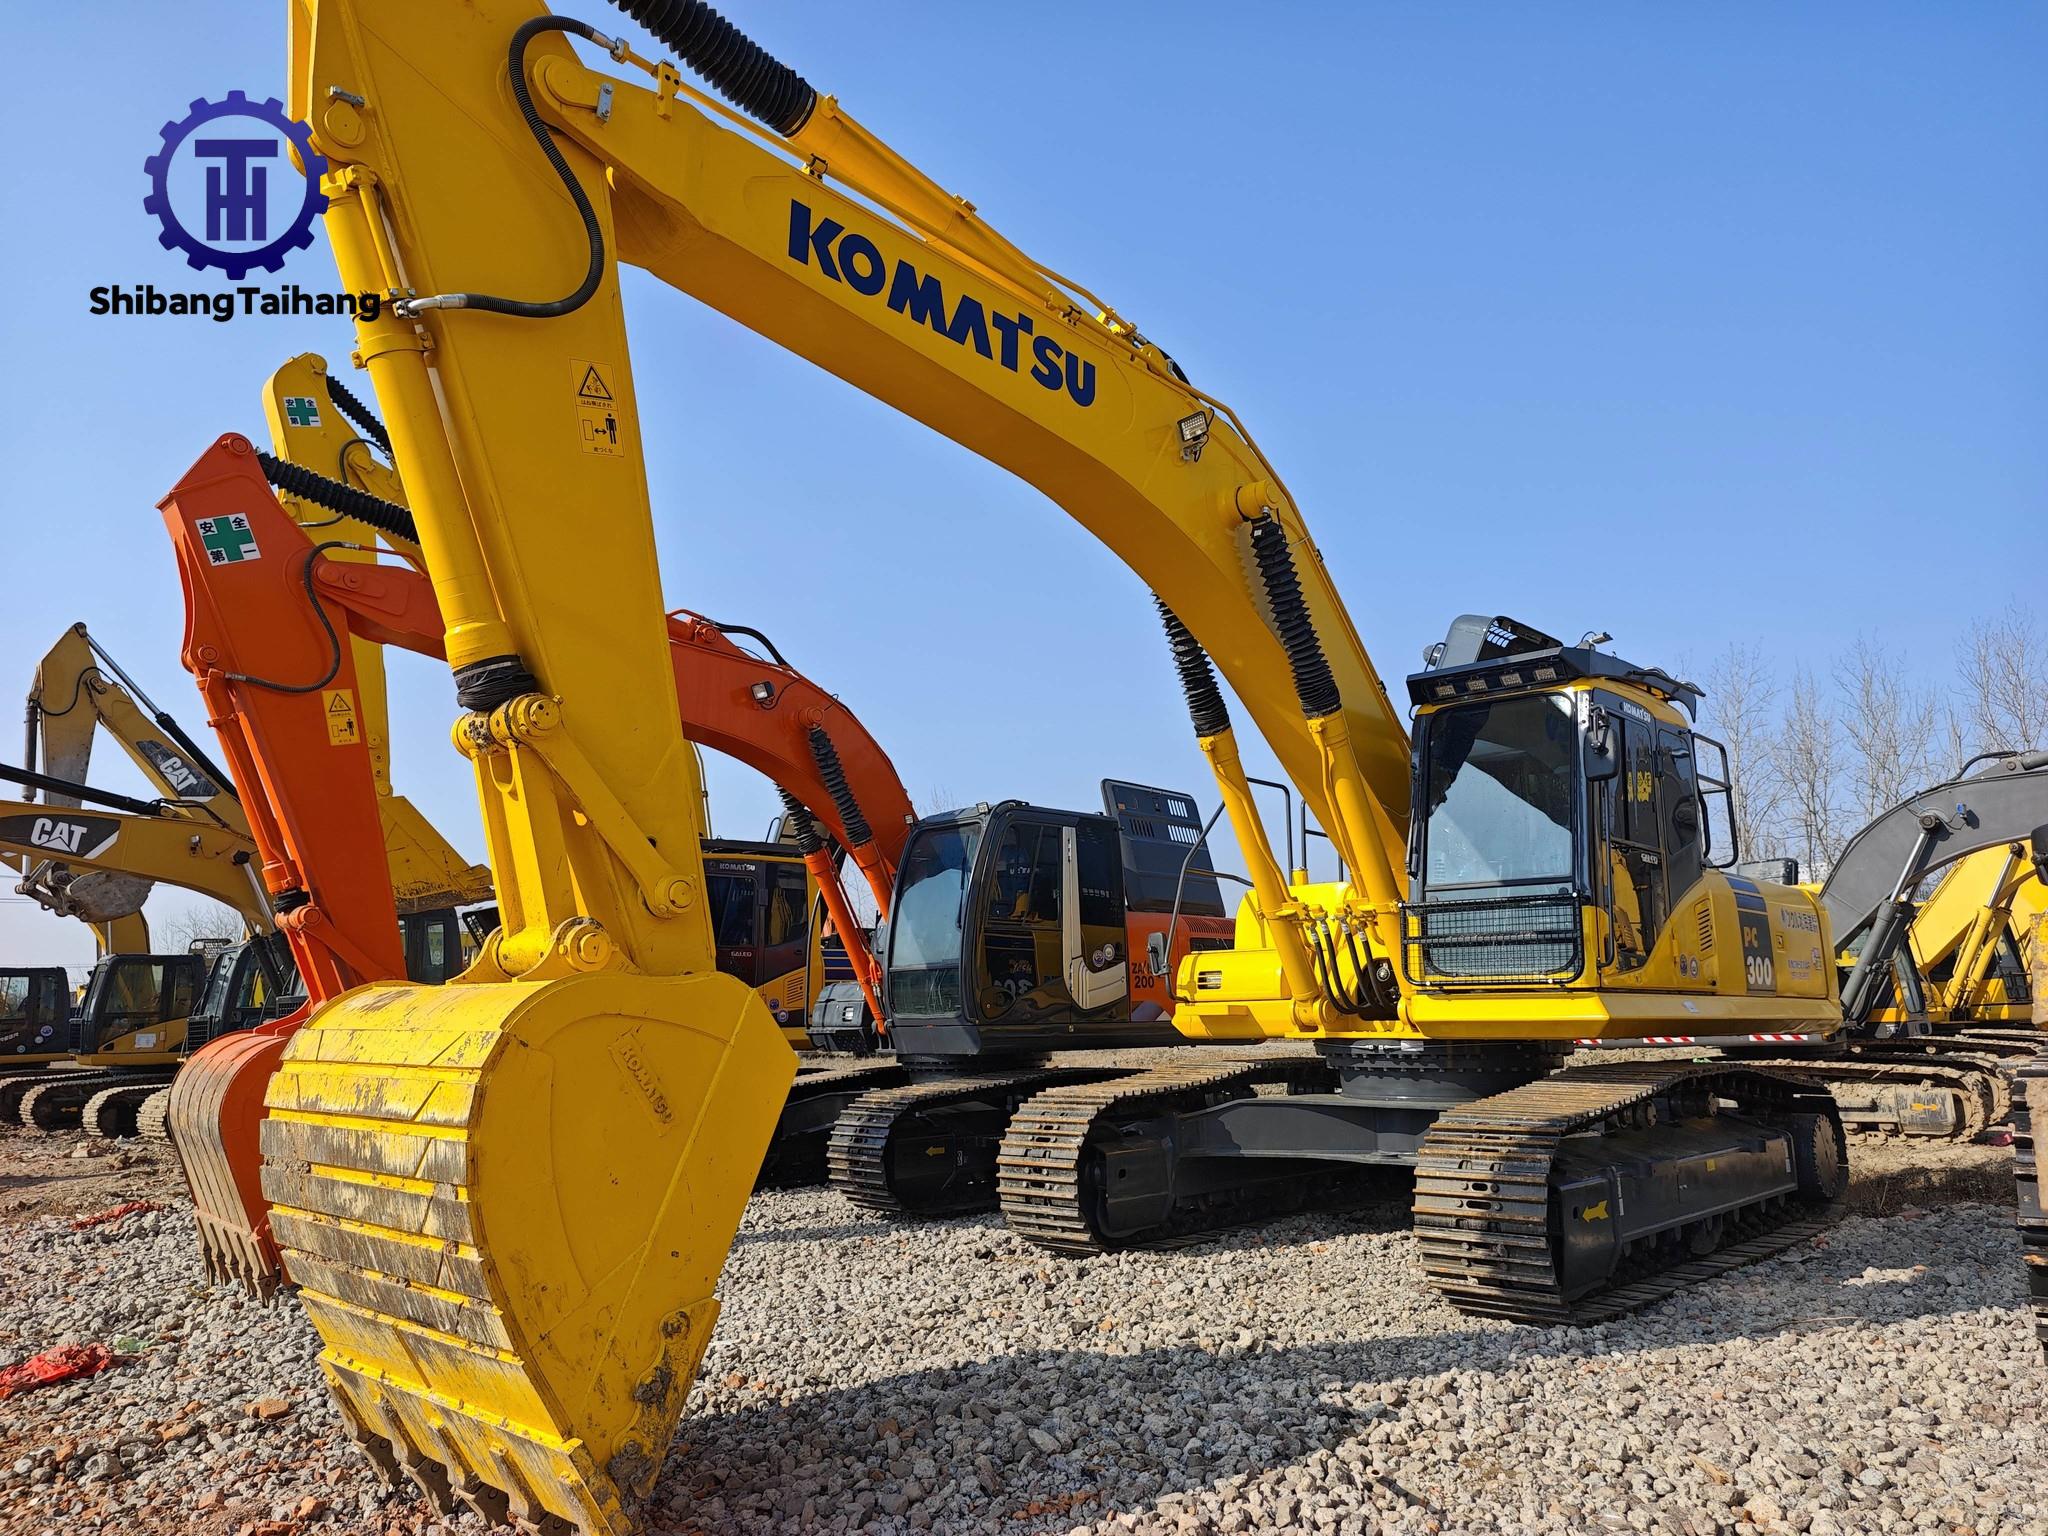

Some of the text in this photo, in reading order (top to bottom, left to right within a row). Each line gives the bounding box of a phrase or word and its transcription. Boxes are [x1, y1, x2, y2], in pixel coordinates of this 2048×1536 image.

[788, 199, 1096, 407] KOMATSU
[1623, 701, 1651, 723] KOMATSU
[159, 756, 198, 792] CAT
[30, 817, 88, 853] CAT
[719, 862, 756, 872] KOMATSU
[1743, 926, 1758, 948] PC
[1134, 975, 1155, 989] 200
[1746, 955, 1772, 986] 300
